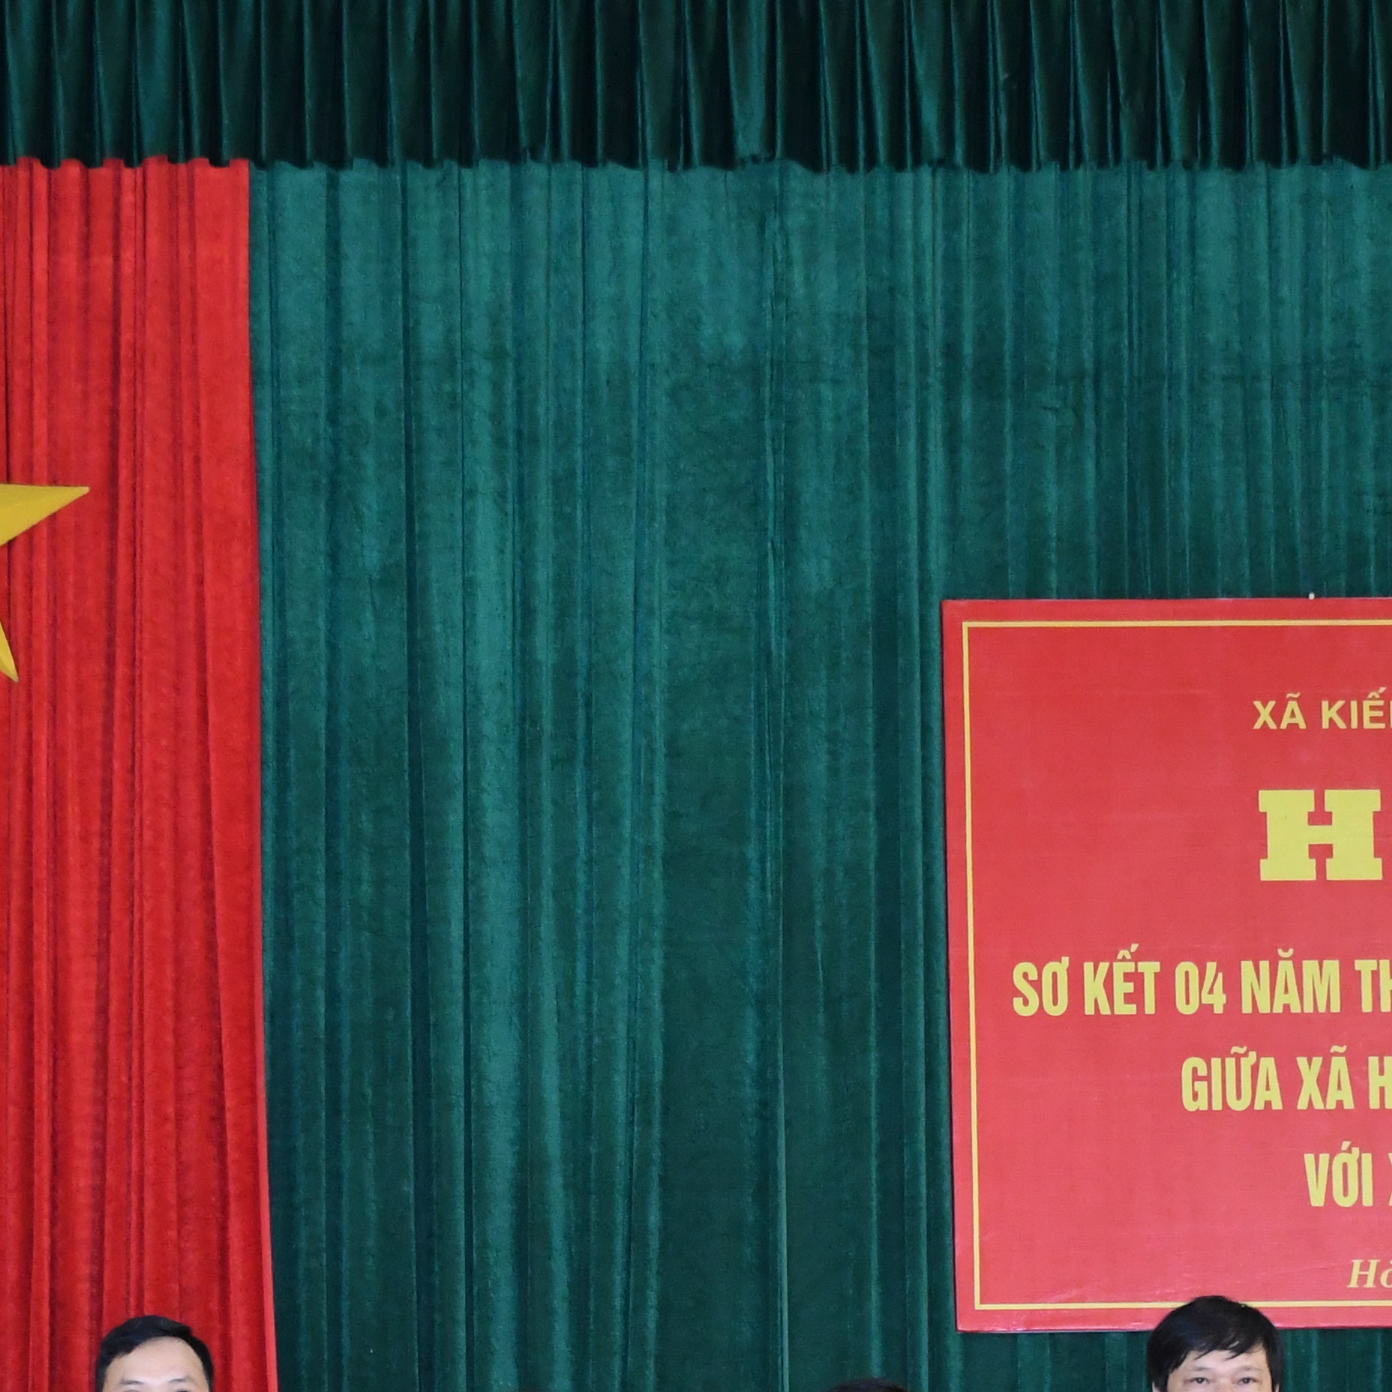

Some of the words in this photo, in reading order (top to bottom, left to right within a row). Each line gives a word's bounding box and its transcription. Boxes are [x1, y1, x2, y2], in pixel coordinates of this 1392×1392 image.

[1253, 692, 1306, 729] XÃ
[1012, 956, 1070, 1016] SƠ
[1083, 943, 1160, 1015] KẾT
[1174, 961, 1226, 1014] 04
[1241, 948, 1342, 1014] NĂM
[1181, 1046, 1283, 1112] GIỮA
[1297, 1045, 1355, 1111] XÃ
[1304, 1141, 1374, 1207] VỚI
